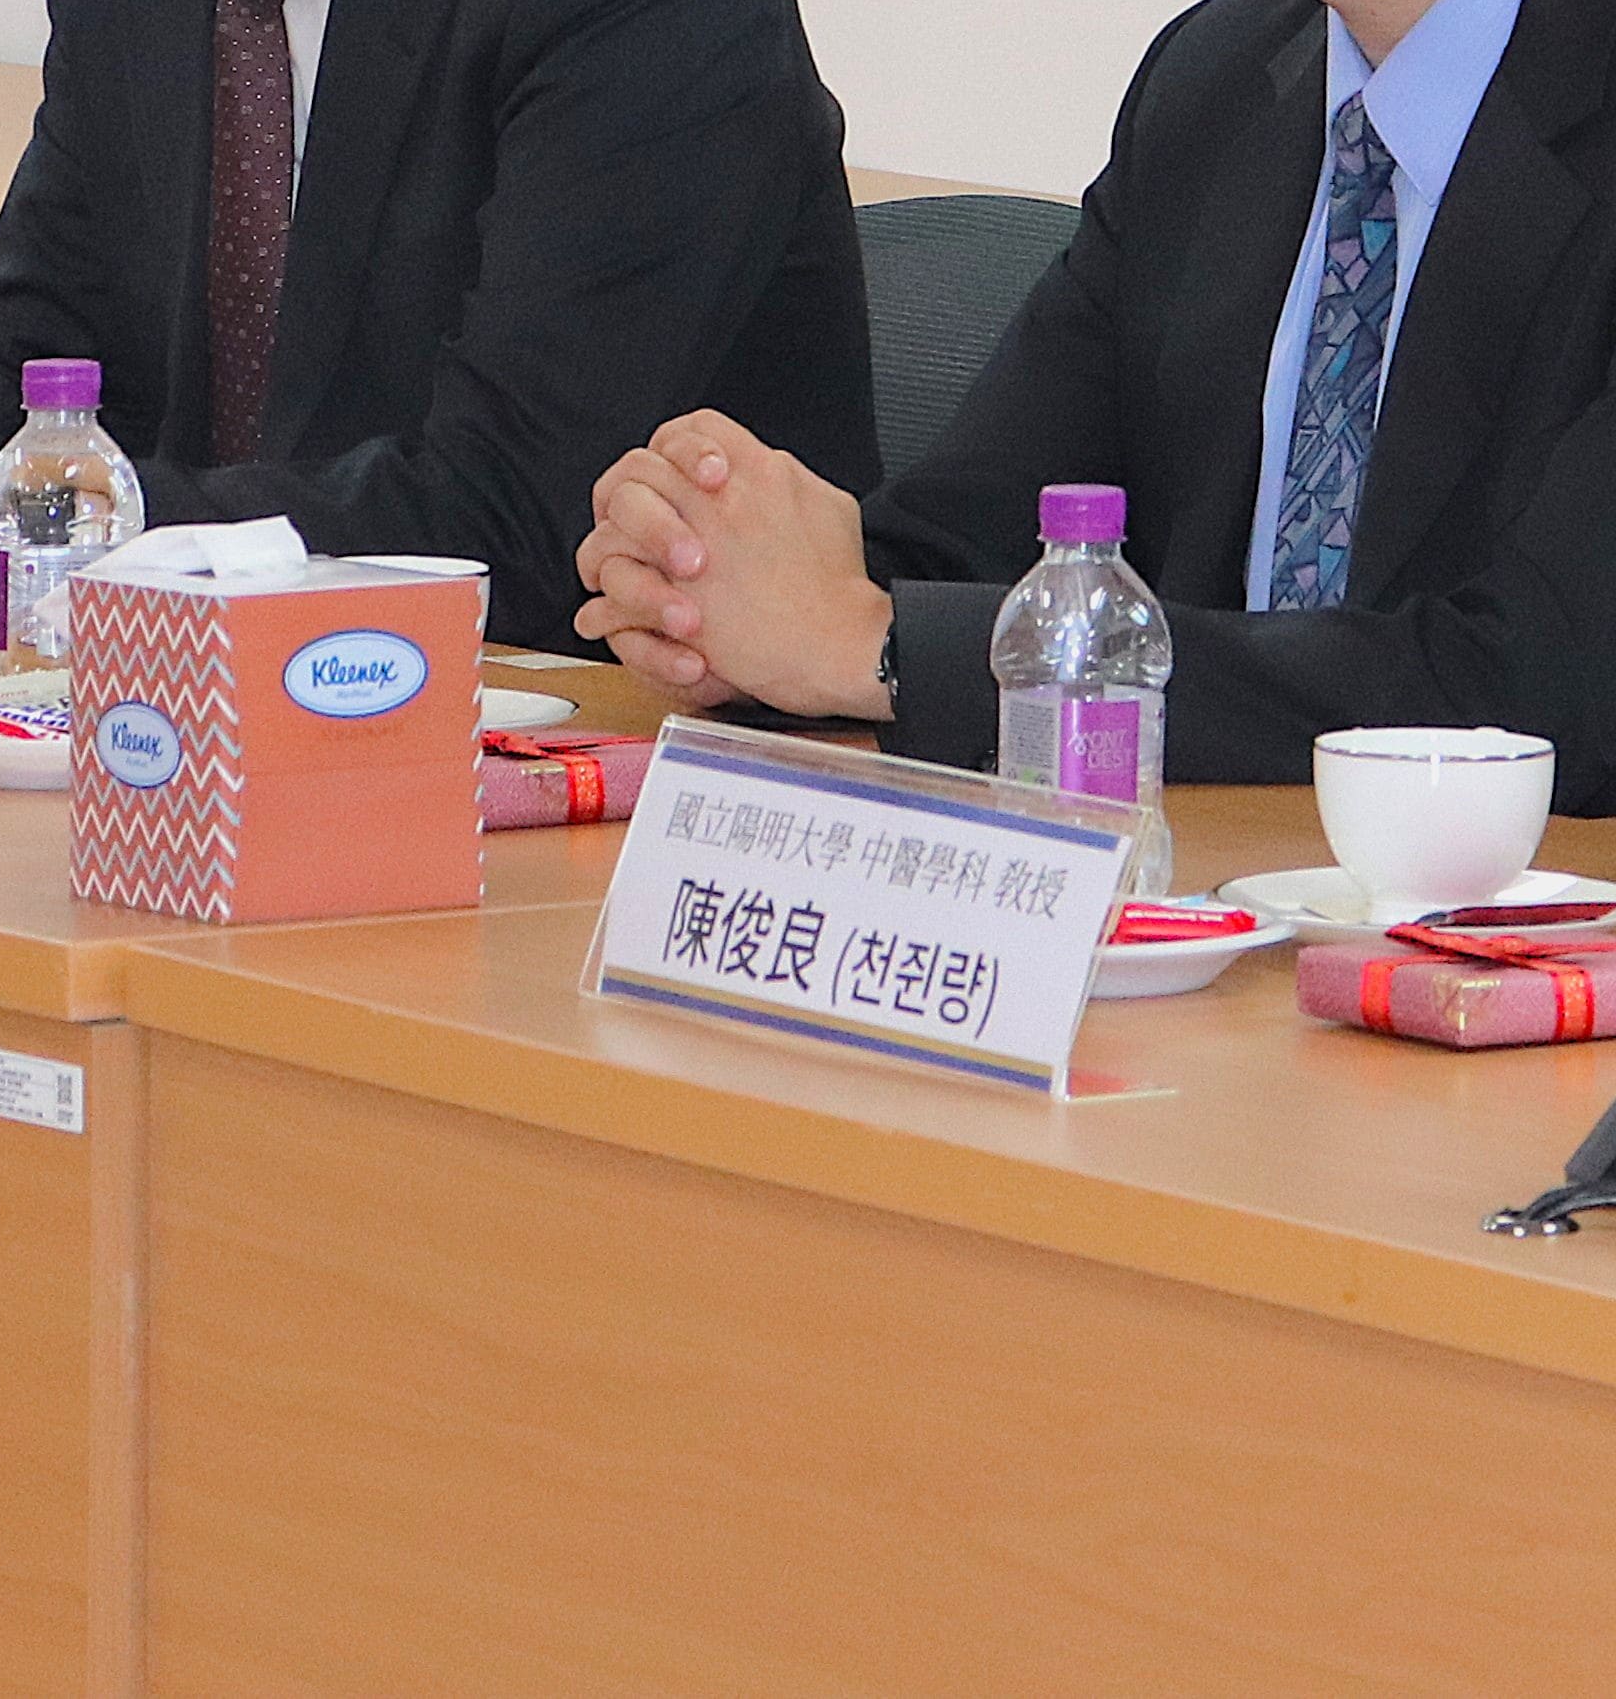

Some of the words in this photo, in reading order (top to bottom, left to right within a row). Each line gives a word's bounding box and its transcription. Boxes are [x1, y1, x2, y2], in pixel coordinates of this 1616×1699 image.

[311, 656, 398, 689] Kleenex
[112, 722, 163, 762] Kleenex
[665, 790, 852, 870] 國立陽明大學
[859, 832, 988, 903] 中醫學科
[662, 879, 828, 992] 陳俊良
[831, 928, 1000, 1040] (천쥔량)
